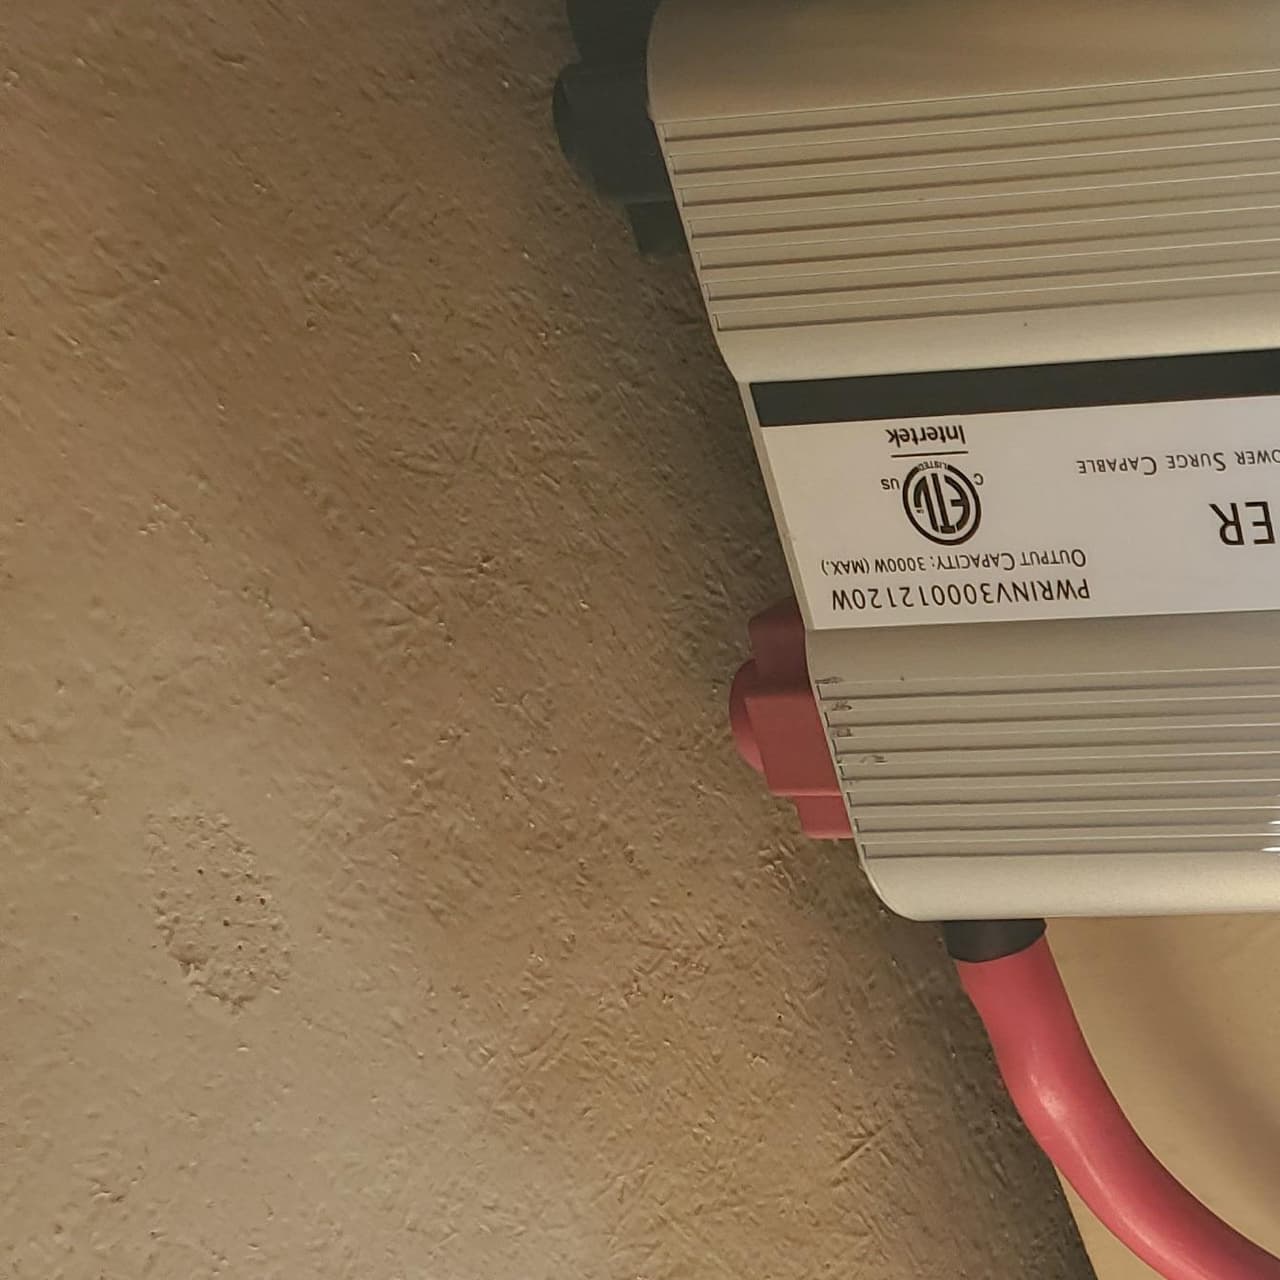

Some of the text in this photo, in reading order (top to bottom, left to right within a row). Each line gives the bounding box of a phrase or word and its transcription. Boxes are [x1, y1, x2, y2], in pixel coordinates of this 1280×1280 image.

[885, 425, 966, 448] Intertek
[1075, 456, 1158, 477] CAPABLE
[1165, 451, 1226, 473] SURGE
[880, 477, 900, 490] US
[821, 548, 1086, 576] OUTPUT CAPACITY: 3000W (MAX.)
[831, 578, 1090, 610] PWRINV300012120W
